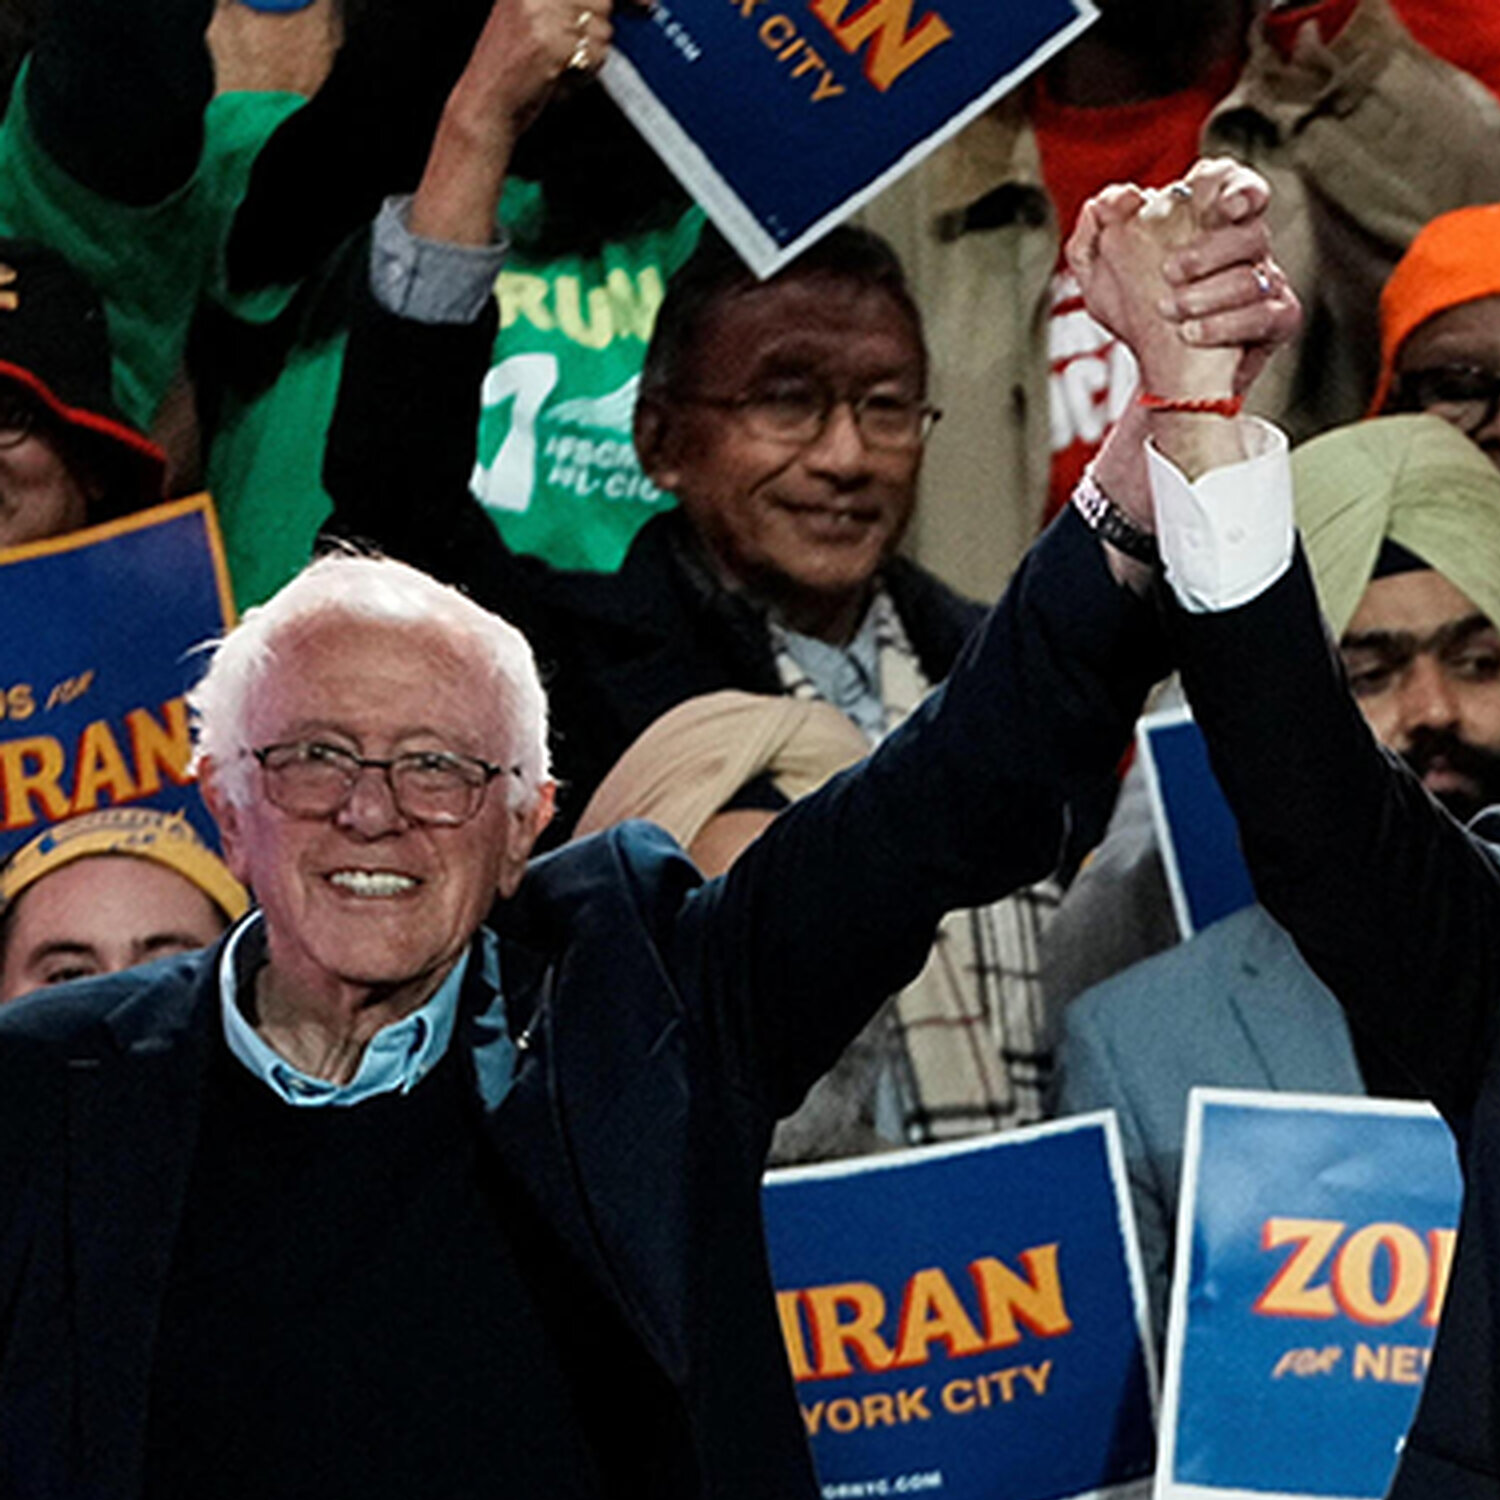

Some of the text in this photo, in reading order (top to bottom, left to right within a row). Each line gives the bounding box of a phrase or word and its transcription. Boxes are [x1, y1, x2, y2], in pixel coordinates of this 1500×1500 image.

[758, 14, 846, 102] CITY
[0, 696, 198, 831] RAN
[801, 1359, 1053, 1436] YORK CITY
[1353, 1342, 1433, 1386] NE
